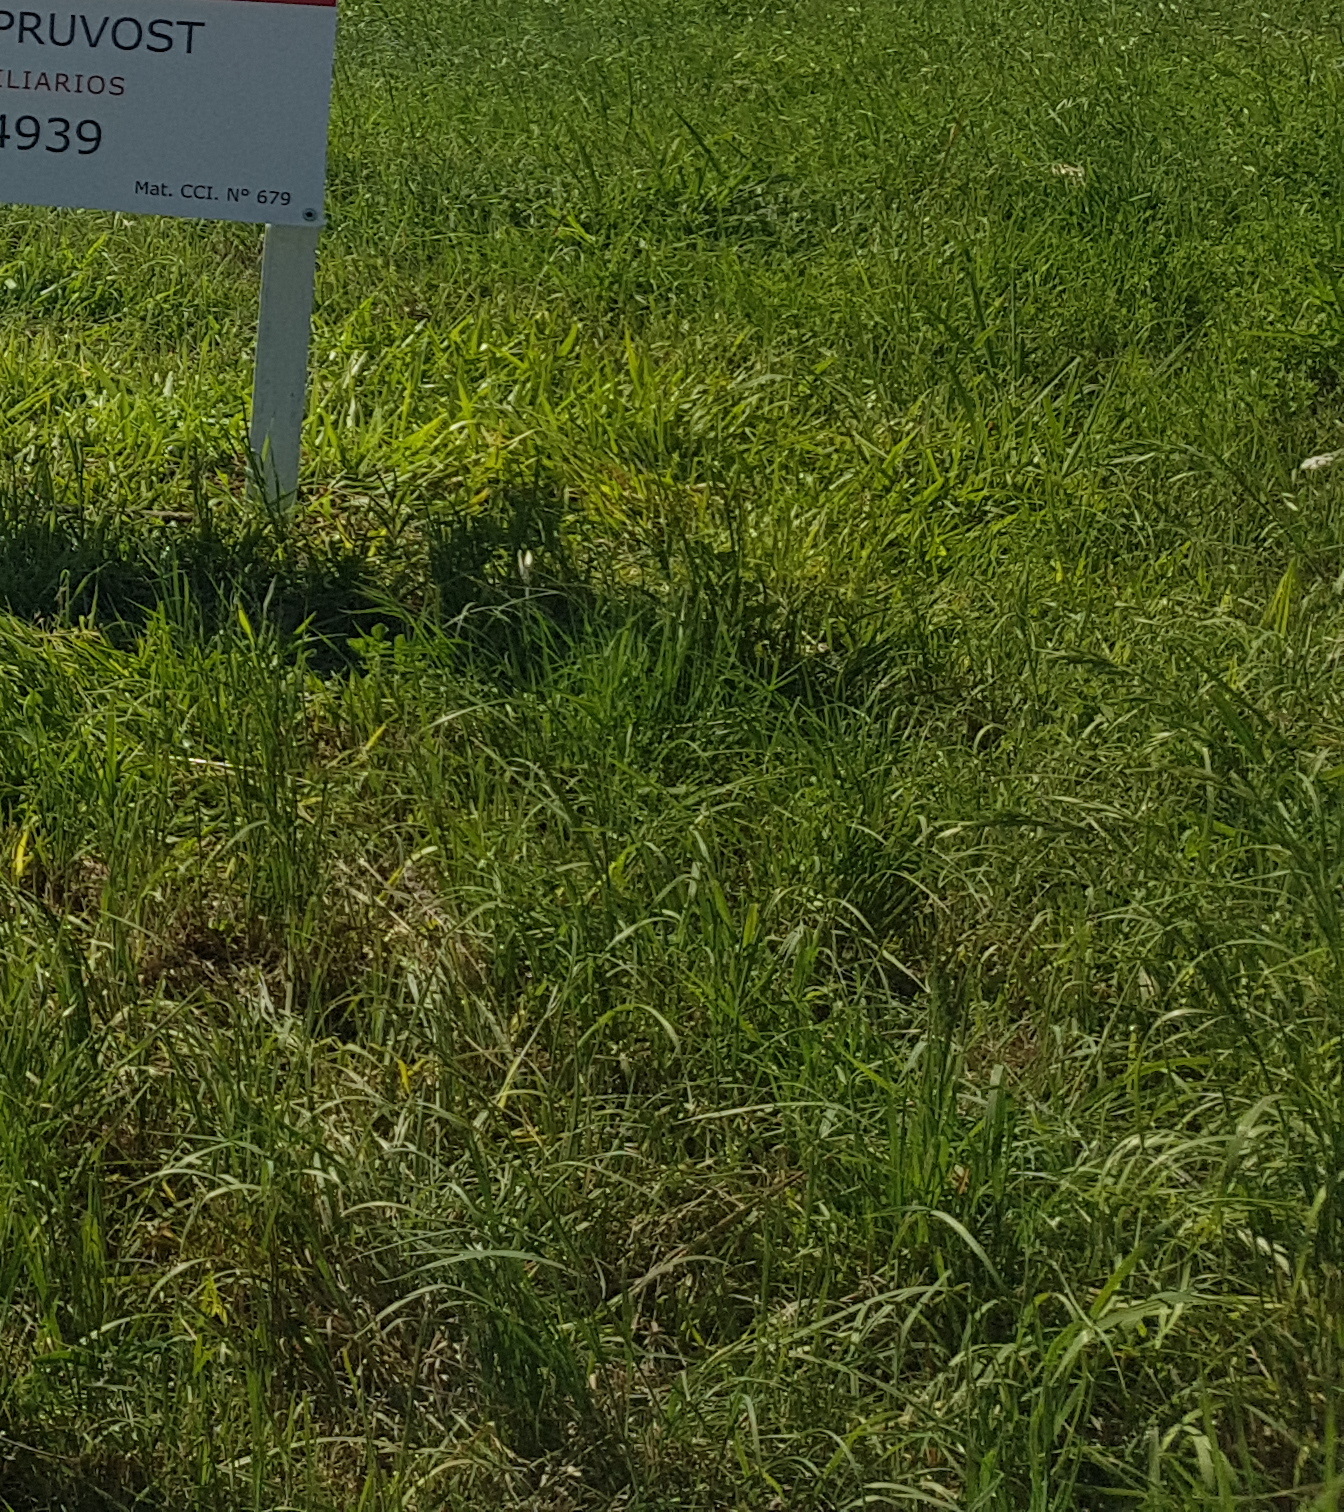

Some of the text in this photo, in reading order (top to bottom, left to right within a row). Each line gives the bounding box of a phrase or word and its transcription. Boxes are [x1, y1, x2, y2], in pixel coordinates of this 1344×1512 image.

[134, 180, 173, 198] Mat.
[180, 183, 219, 201] CCI.
[256, 189, 292, 206] 679
